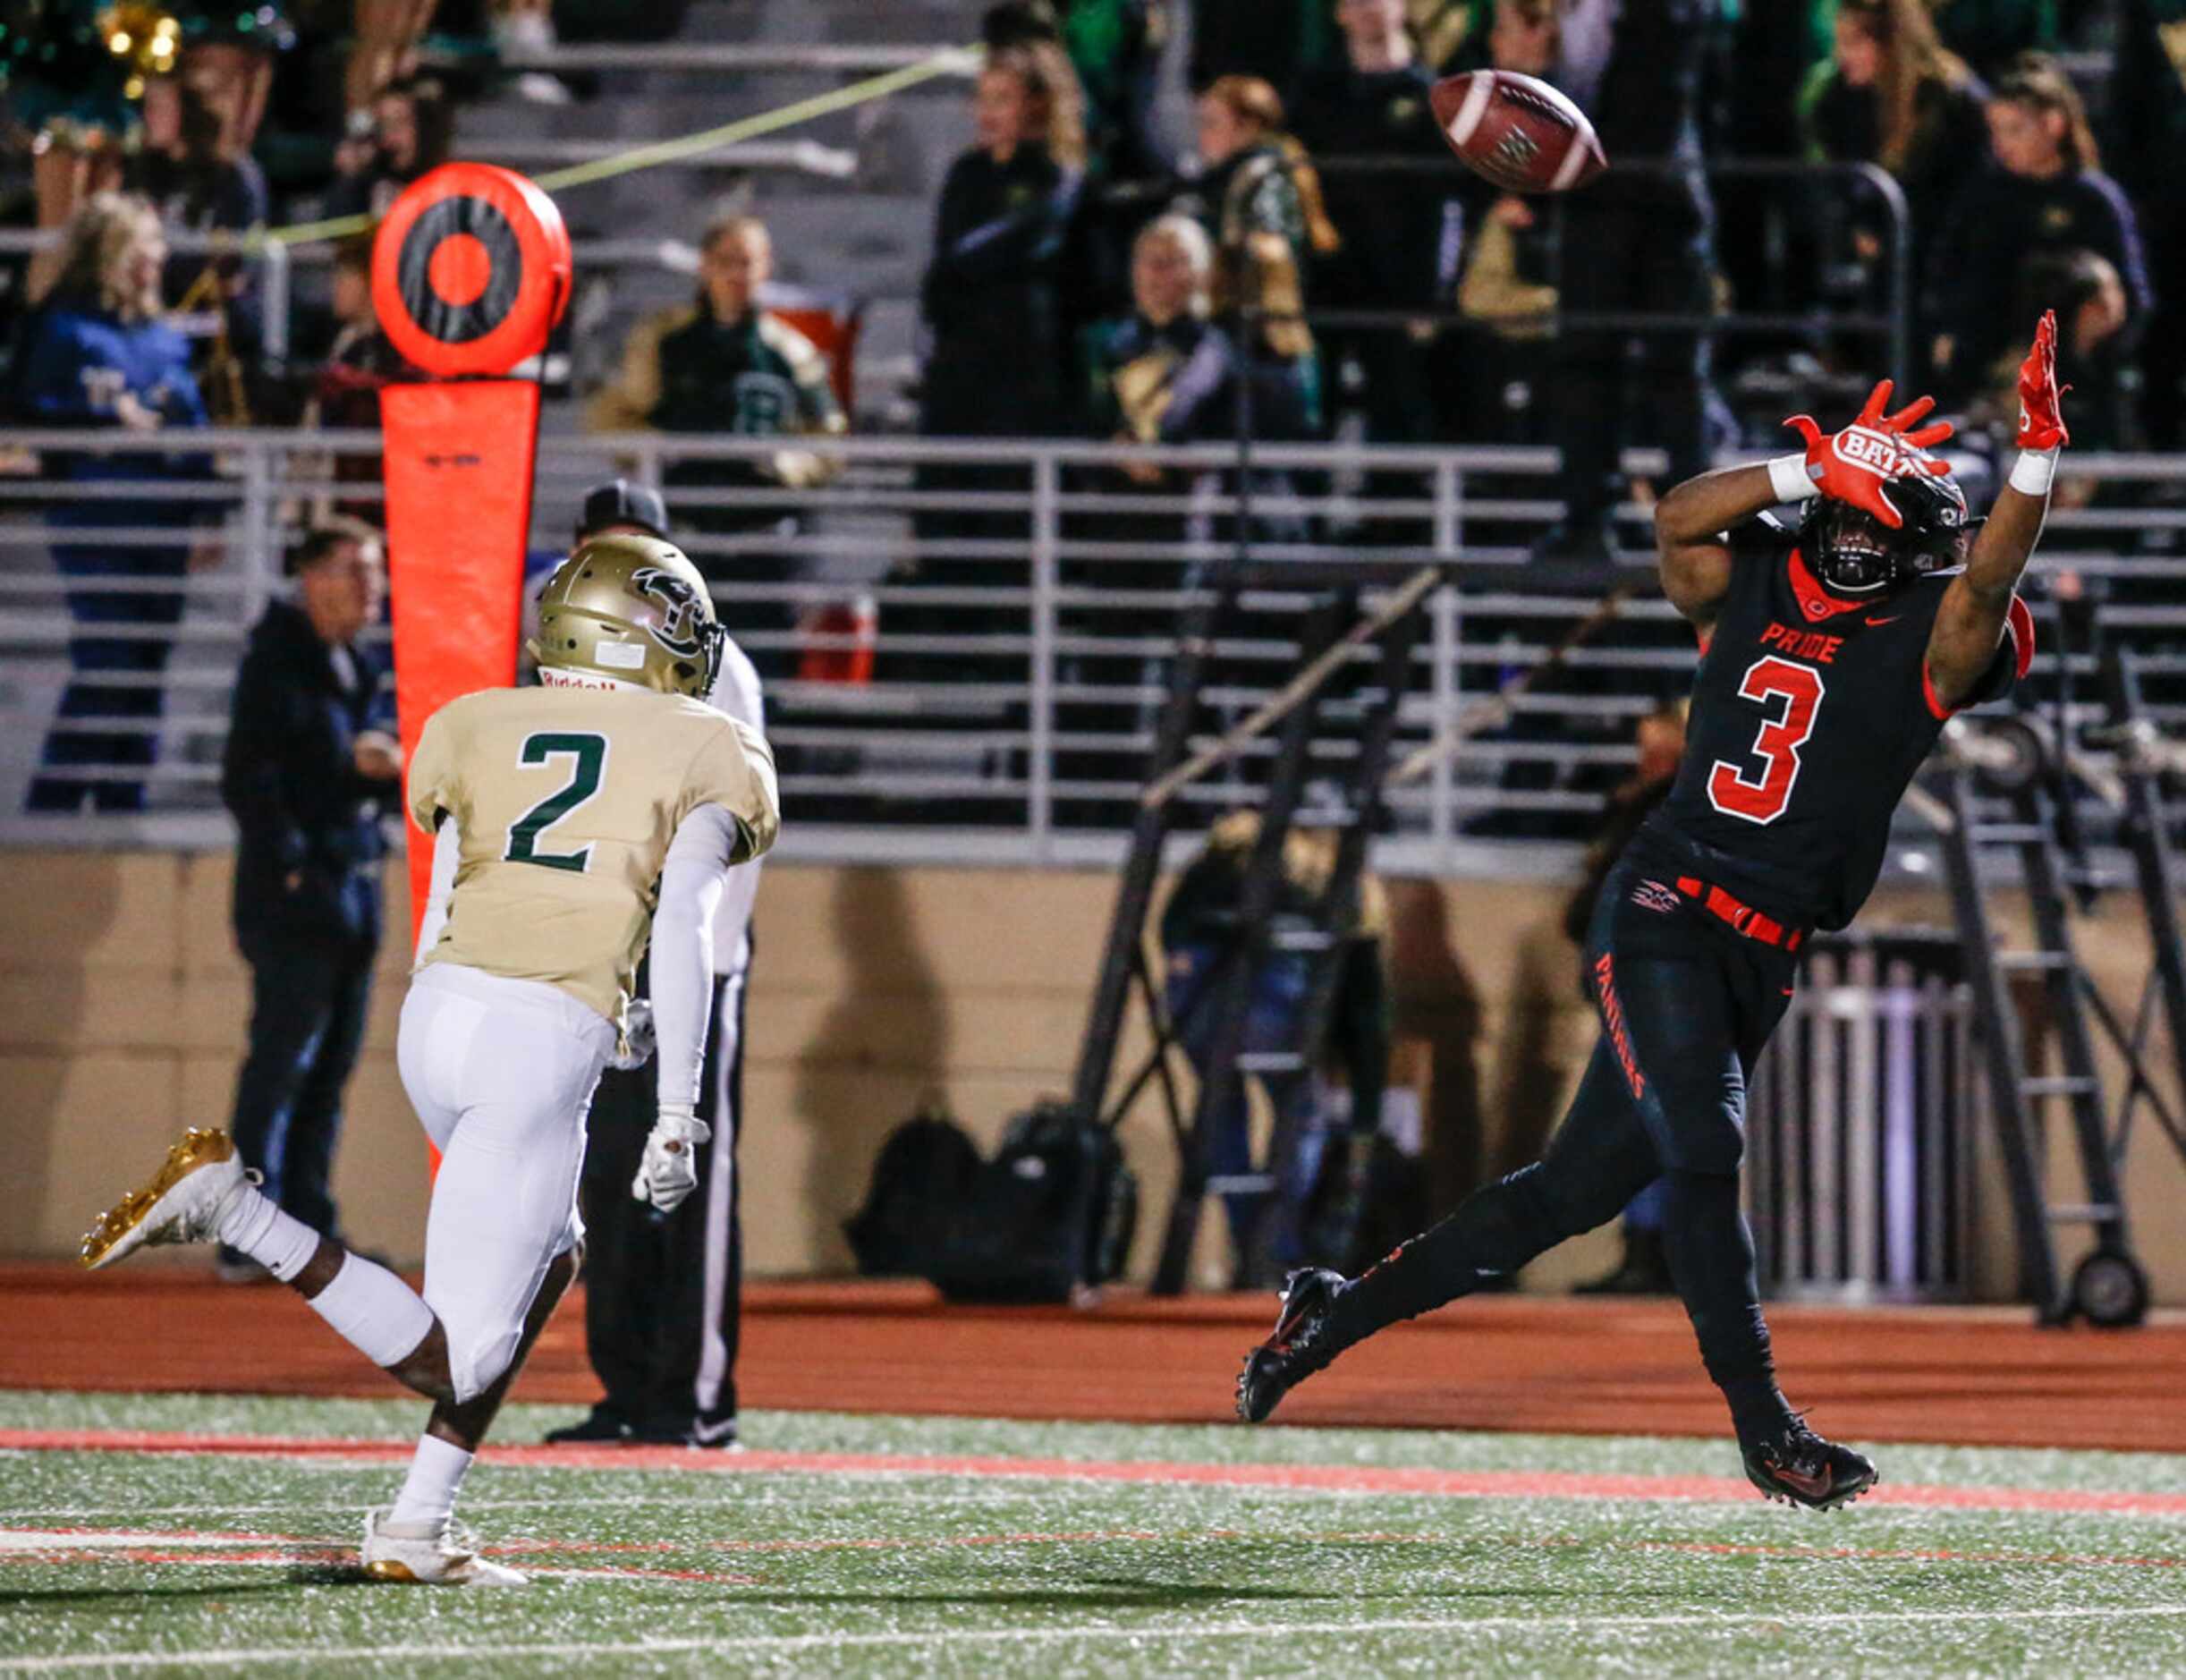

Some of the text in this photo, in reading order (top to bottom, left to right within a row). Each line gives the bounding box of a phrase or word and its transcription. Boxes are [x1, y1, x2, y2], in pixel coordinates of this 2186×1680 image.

[1759, 622, 1844, 664] PRIDE
[501, 729, 611, 874] 2
[1707, 655, 1826, 826] 3
